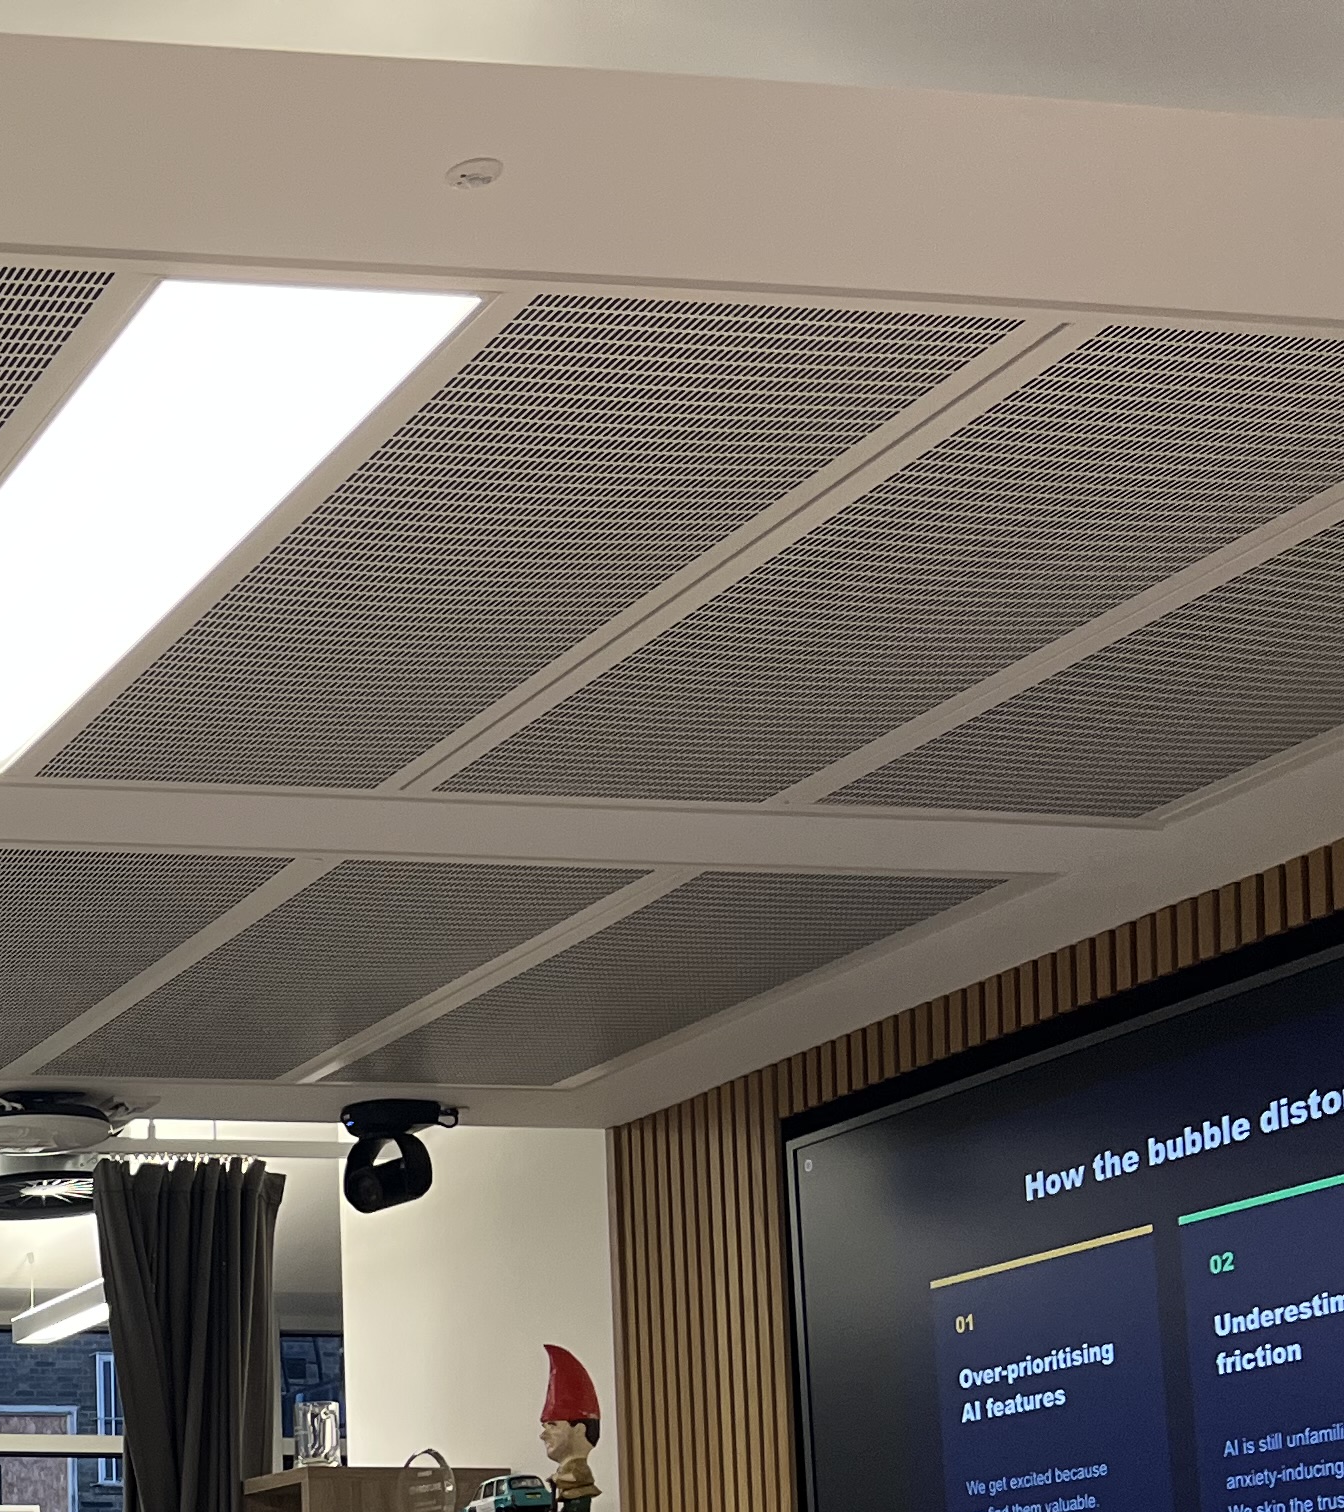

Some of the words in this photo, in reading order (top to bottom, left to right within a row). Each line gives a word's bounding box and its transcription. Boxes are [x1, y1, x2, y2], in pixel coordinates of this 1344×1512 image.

[1025, 1165, 1085, 1202] How
[1093, 1150, 1140, 1182] the
[1148, 1115, 1251, 1166] bubble
[1259, 1089, 1344, 1133] disto
[1209, 1251, 1235, 1274] 02
[955, 1313, 974, 1334] 01
[958, 1342, 1115, 1389] Over-prioritising
[1216, 1343, 1303, 1375] friction
[961, 1400, 982, 1424] AI
[986, 1388, 1067, 1419] features
[1223, 1439, 1239, 1458] AI
[1242, 1437, 1255, 1455] is
[1258, 1432, 1283, 1452] still
[965, 1480, 986, 1496] We
[988, 1476, 1008, 1497] get
[1010, 1468, 1052, 1489] excited
[1055, 1463, 1108, 1483] because
